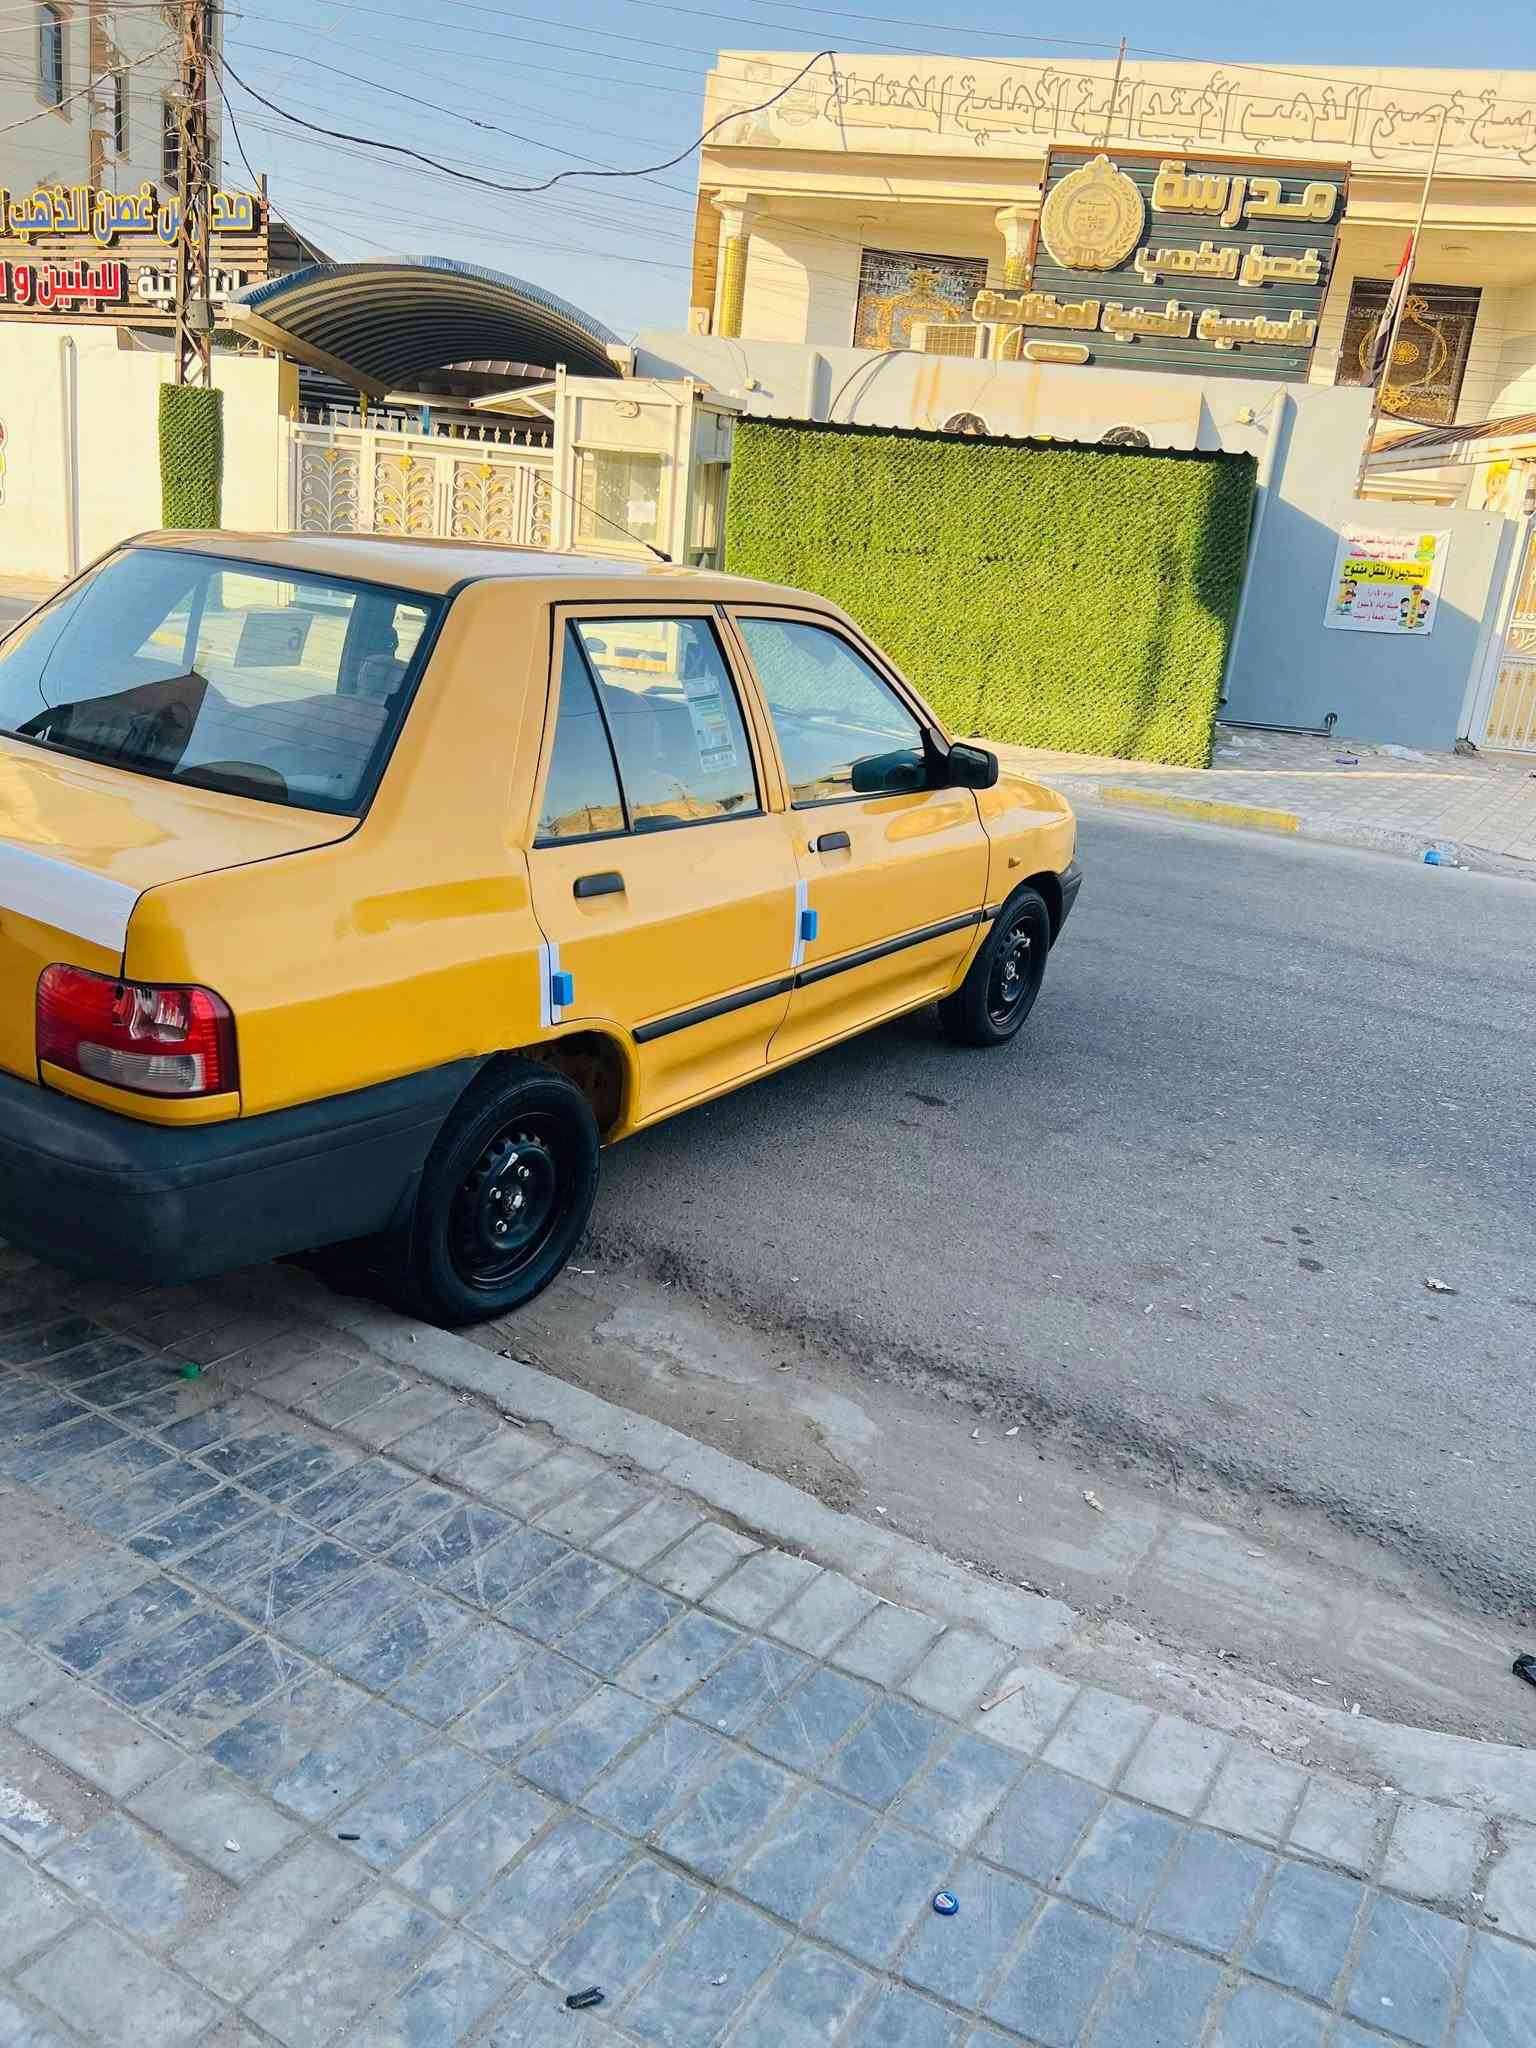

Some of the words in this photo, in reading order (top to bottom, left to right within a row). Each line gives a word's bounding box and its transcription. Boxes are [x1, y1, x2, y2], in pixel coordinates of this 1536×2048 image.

[1240, 84, 1373, 154] الذهب
[9, 184, 90, 243] الذهب
[93, 182, 154, 244] غصن
[158, 184, 253, 244] مدرس
[1152, 159, 1338, 228] مدرسة
[37, 259, 122, 308] للبنين
[1135, 240, 1240, 284] الذهب
[1238, 244, 1322, 287] غصن
